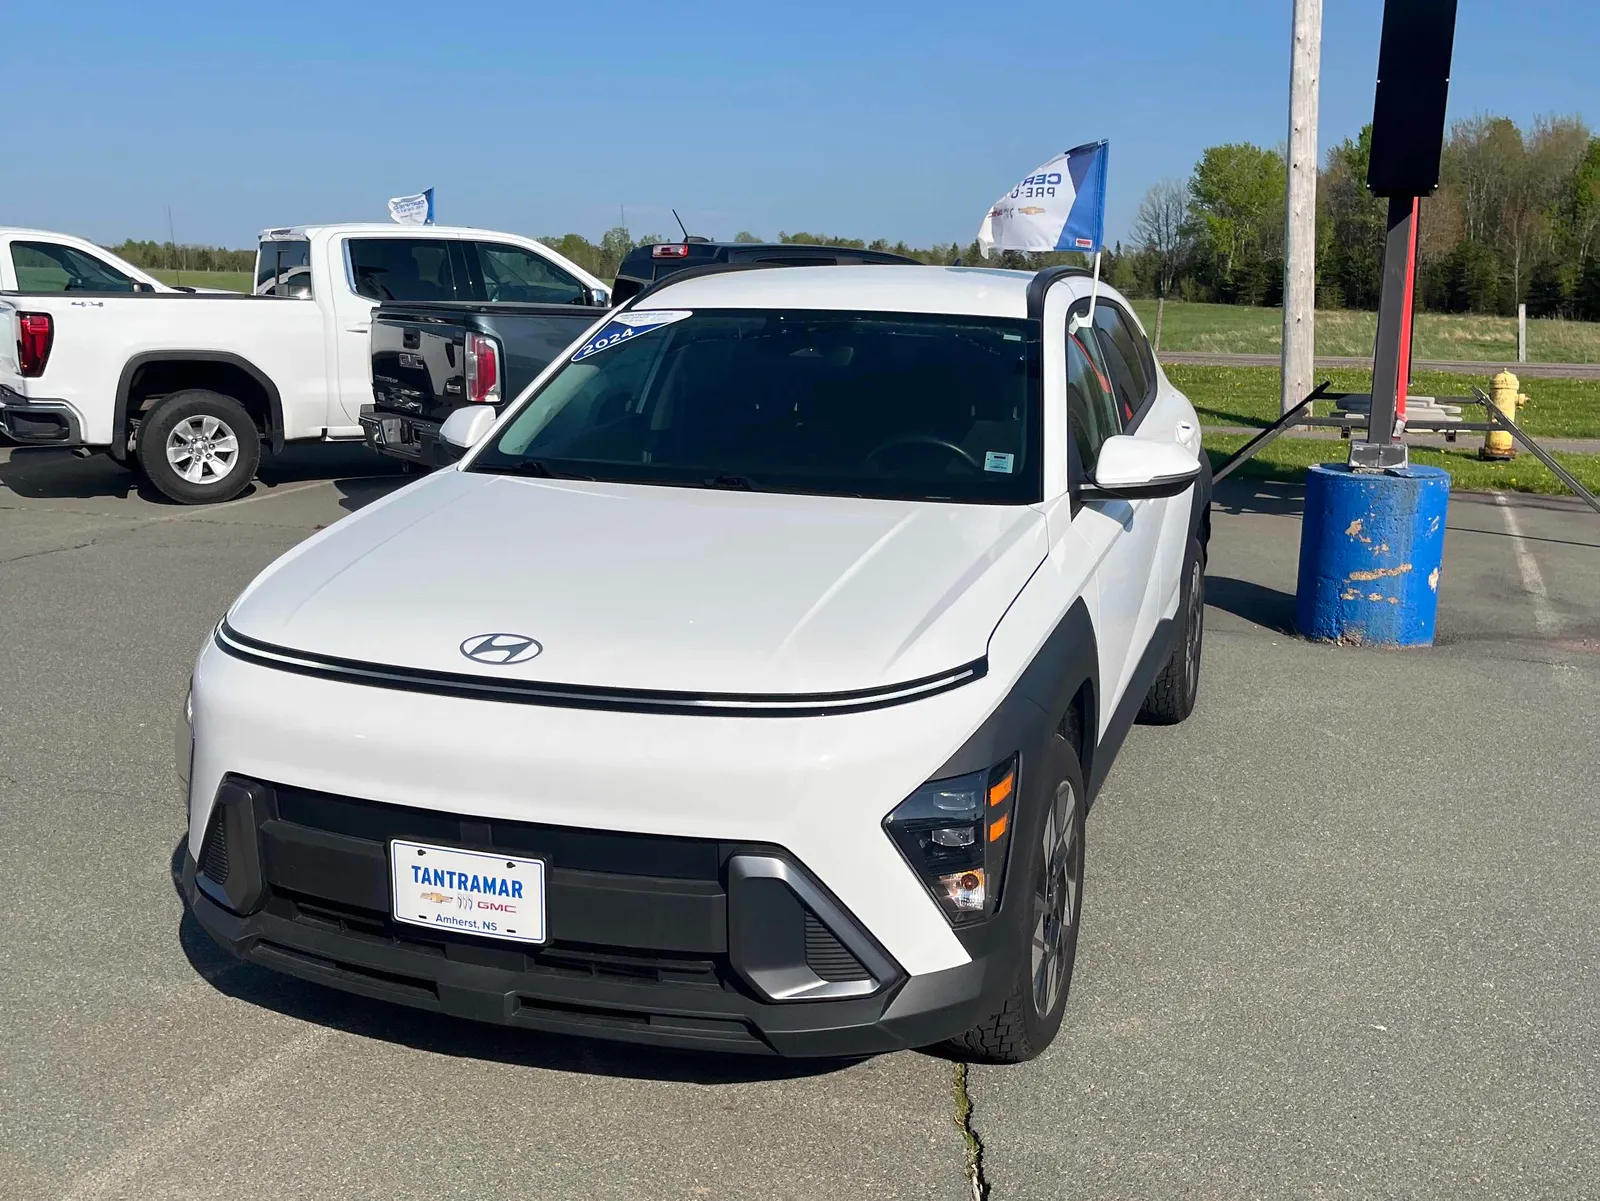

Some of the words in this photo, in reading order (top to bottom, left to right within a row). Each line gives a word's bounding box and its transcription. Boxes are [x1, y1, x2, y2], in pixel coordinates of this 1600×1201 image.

[583, 328, 635, 355] 2024
[411, 865, 524, 899] TANTRAMAR
[477, 901, 517, 914] GMC
[435, 913, 480, 929] Amherst,
[482, 920, 498, 931] NS
